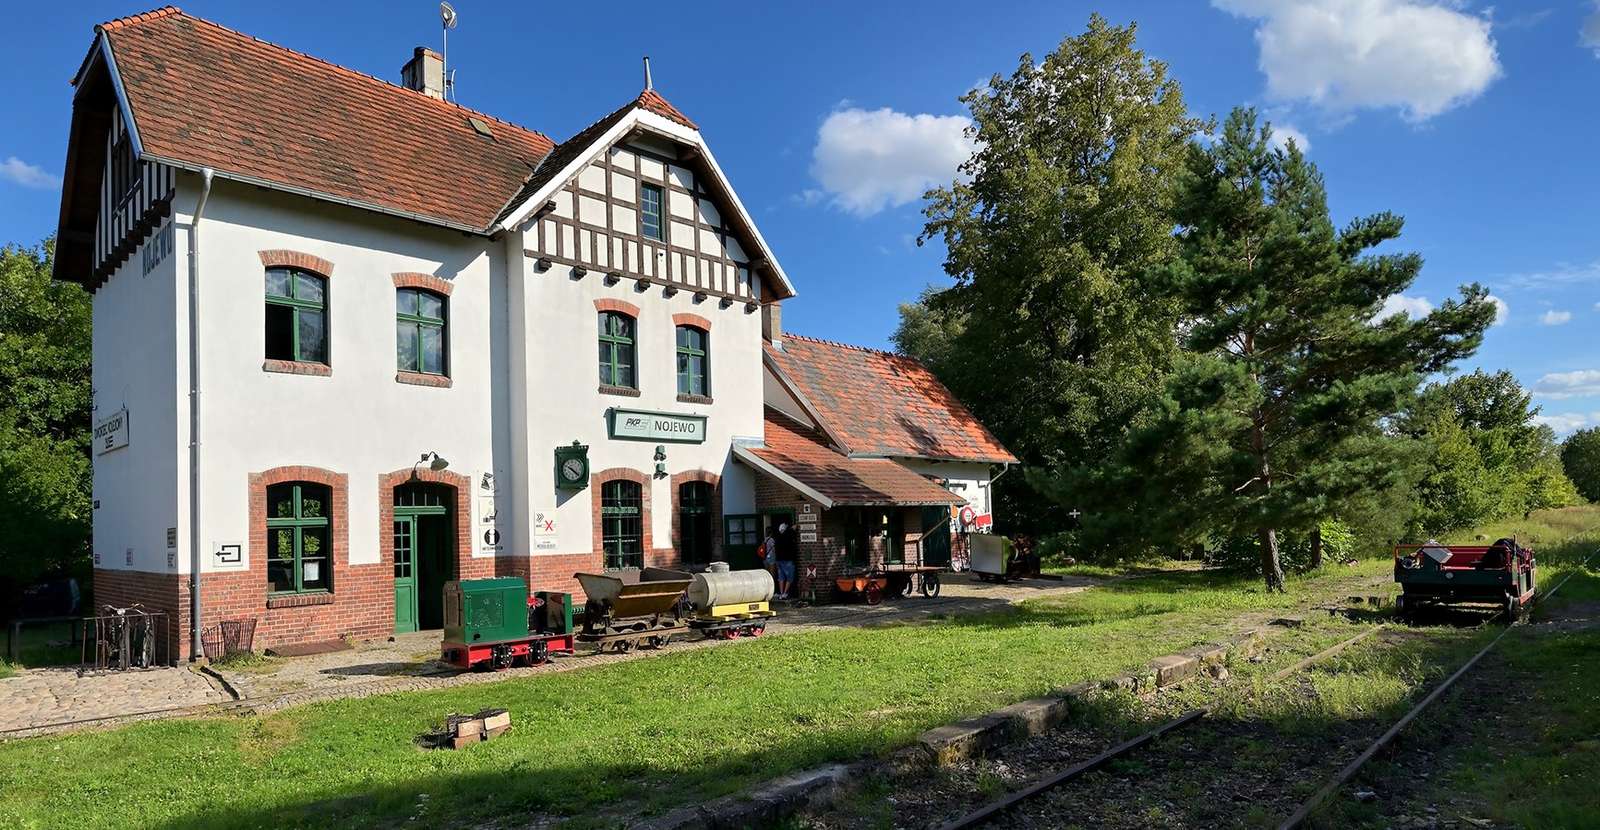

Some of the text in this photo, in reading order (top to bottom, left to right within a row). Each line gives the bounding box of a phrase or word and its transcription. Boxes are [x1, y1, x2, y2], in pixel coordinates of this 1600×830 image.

[142, 221, 172, 279] NOJEWO
[625, 418, 641, 426] PKP
[654, 420, 696, 433] NOJEWO
